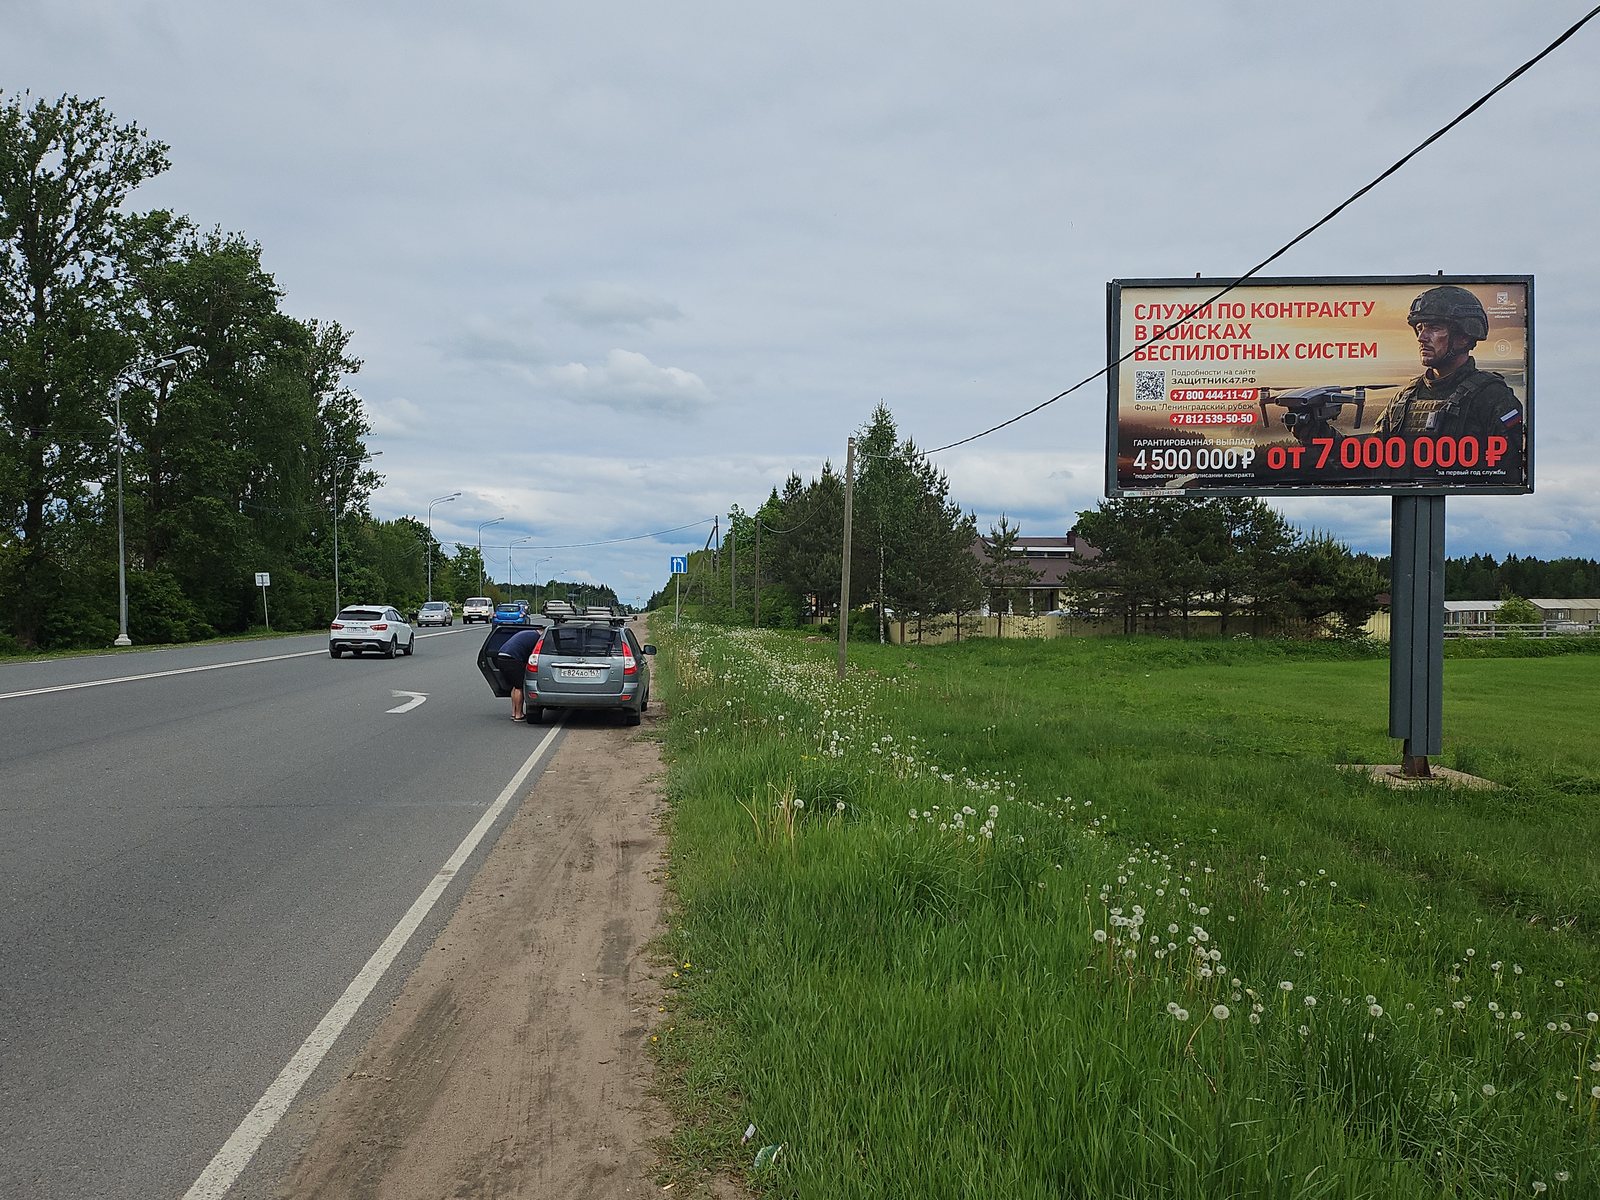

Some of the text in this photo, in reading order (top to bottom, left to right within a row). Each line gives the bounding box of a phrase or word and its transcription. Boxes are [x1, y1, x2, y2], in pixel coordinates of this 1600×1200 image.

[1134, 301, 1376, 320] СЛУЖИ ПО КОНТРАКТУ
[1134, 321, 1252, 341] В ВОЙСКАХ
[1134, 342, 1378, 361] БЕСПИЛОТНЫХ СИСТЕМ
[1171, 369, 1221, 377] Подробности
[1171, 377, 1257, 385] ЗАЩИТНИК47.РФ
[1173, 390, 1254, 400] +7 800 444-11-47
[1134, 403, 1157, 412] Фонд
[1172, 413, 1253, 424] +7 812 539-50-50
[1133, 438, 1256, 447] ГАРАНТИРОВАННАЯ ВЫПЛАТА
[1266, 446, 1306, 470] от
[1312, 437, 1334, 469] 7
[1340, 436, 1407, 469] 000
[1413, 435, 1479, 469] 000
[1133, 448, 1256, 470] 4 500 000 ₽
